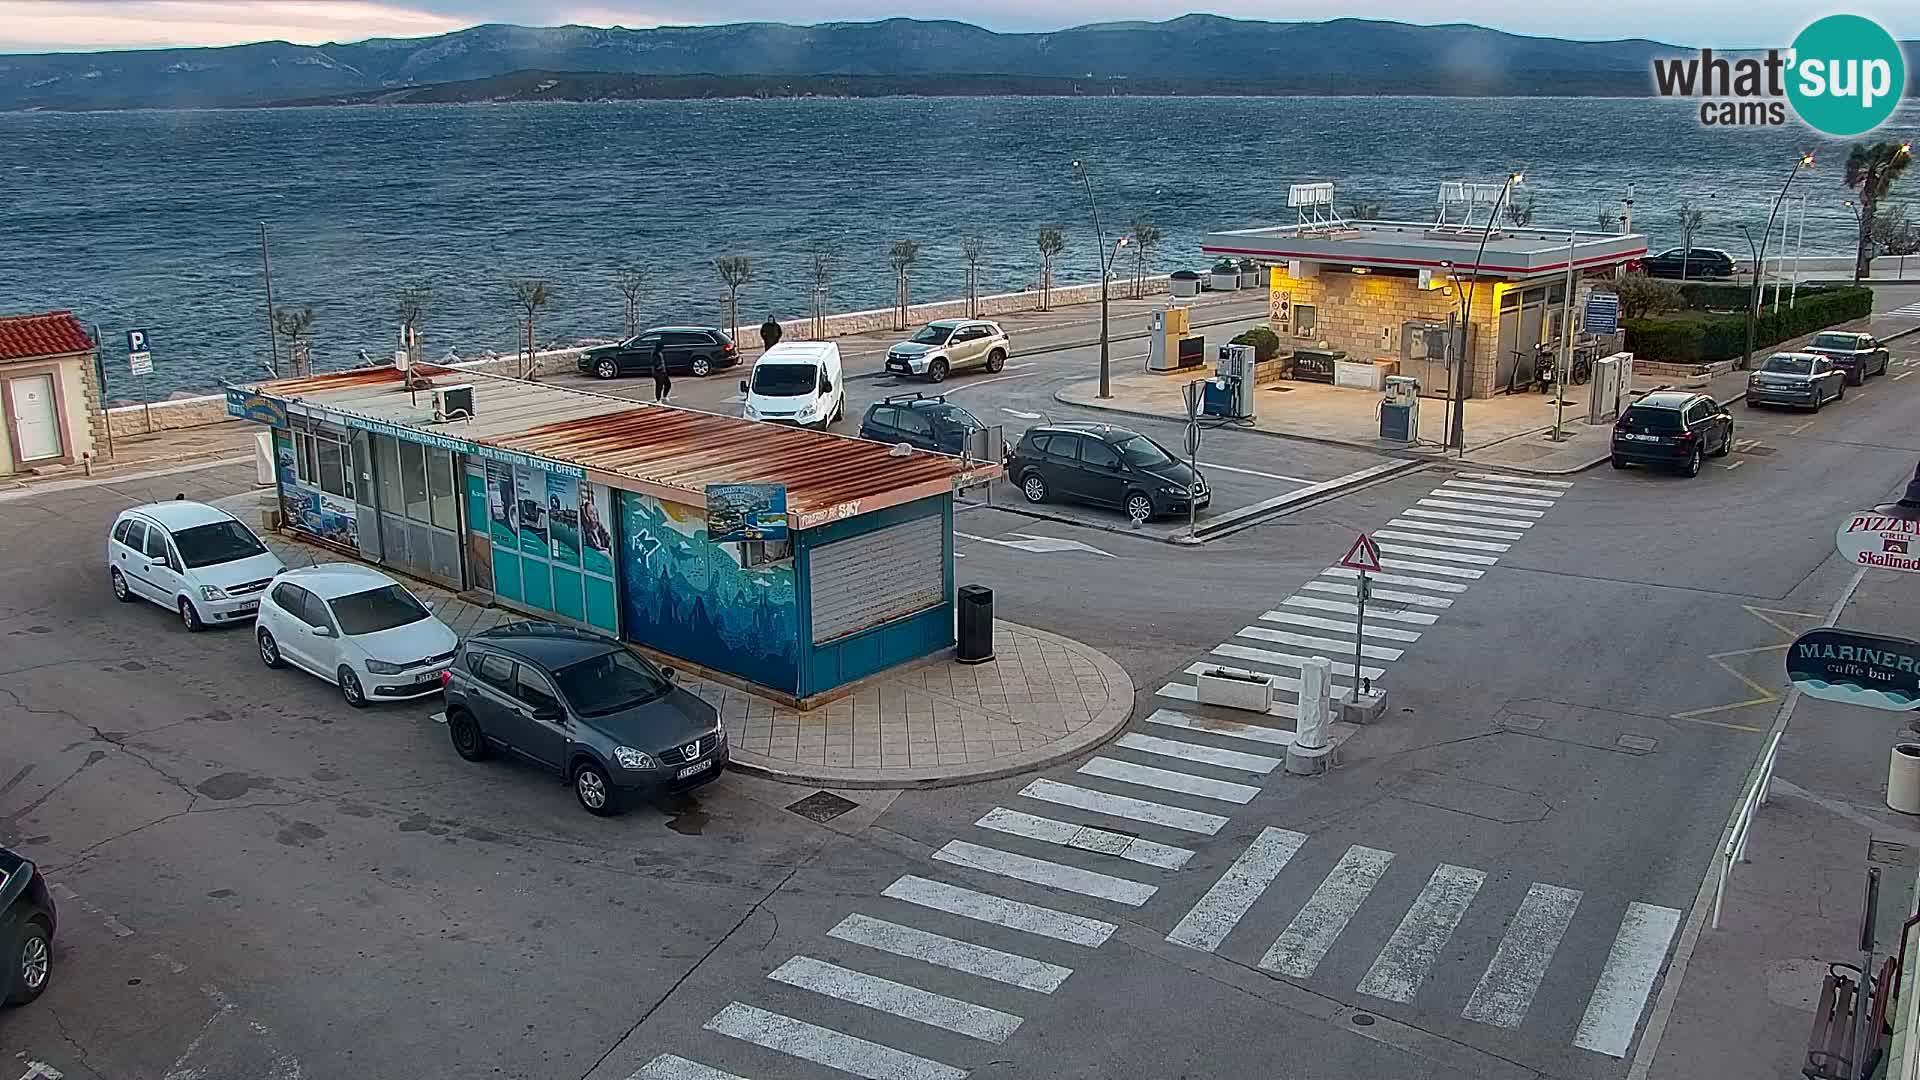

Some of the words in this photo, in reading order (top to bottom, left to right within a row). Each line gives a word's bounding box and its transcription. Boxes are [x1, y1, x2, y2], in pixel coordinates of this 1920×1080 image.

[131, 332, 145, 351] P
[437, 438, 468, 452] POSTAJA
[479, 448, 493, 458] BUS
[495, 451, 527, 465] STATION
[529, 458, 554, 472] TICKET
[556, 462, 583, 477] OFFICE
[1880, 531, 1915, 542] GRILL
[1827, 663, 1864, 674] caffe
[1868, 667, 1895, 681] bar
